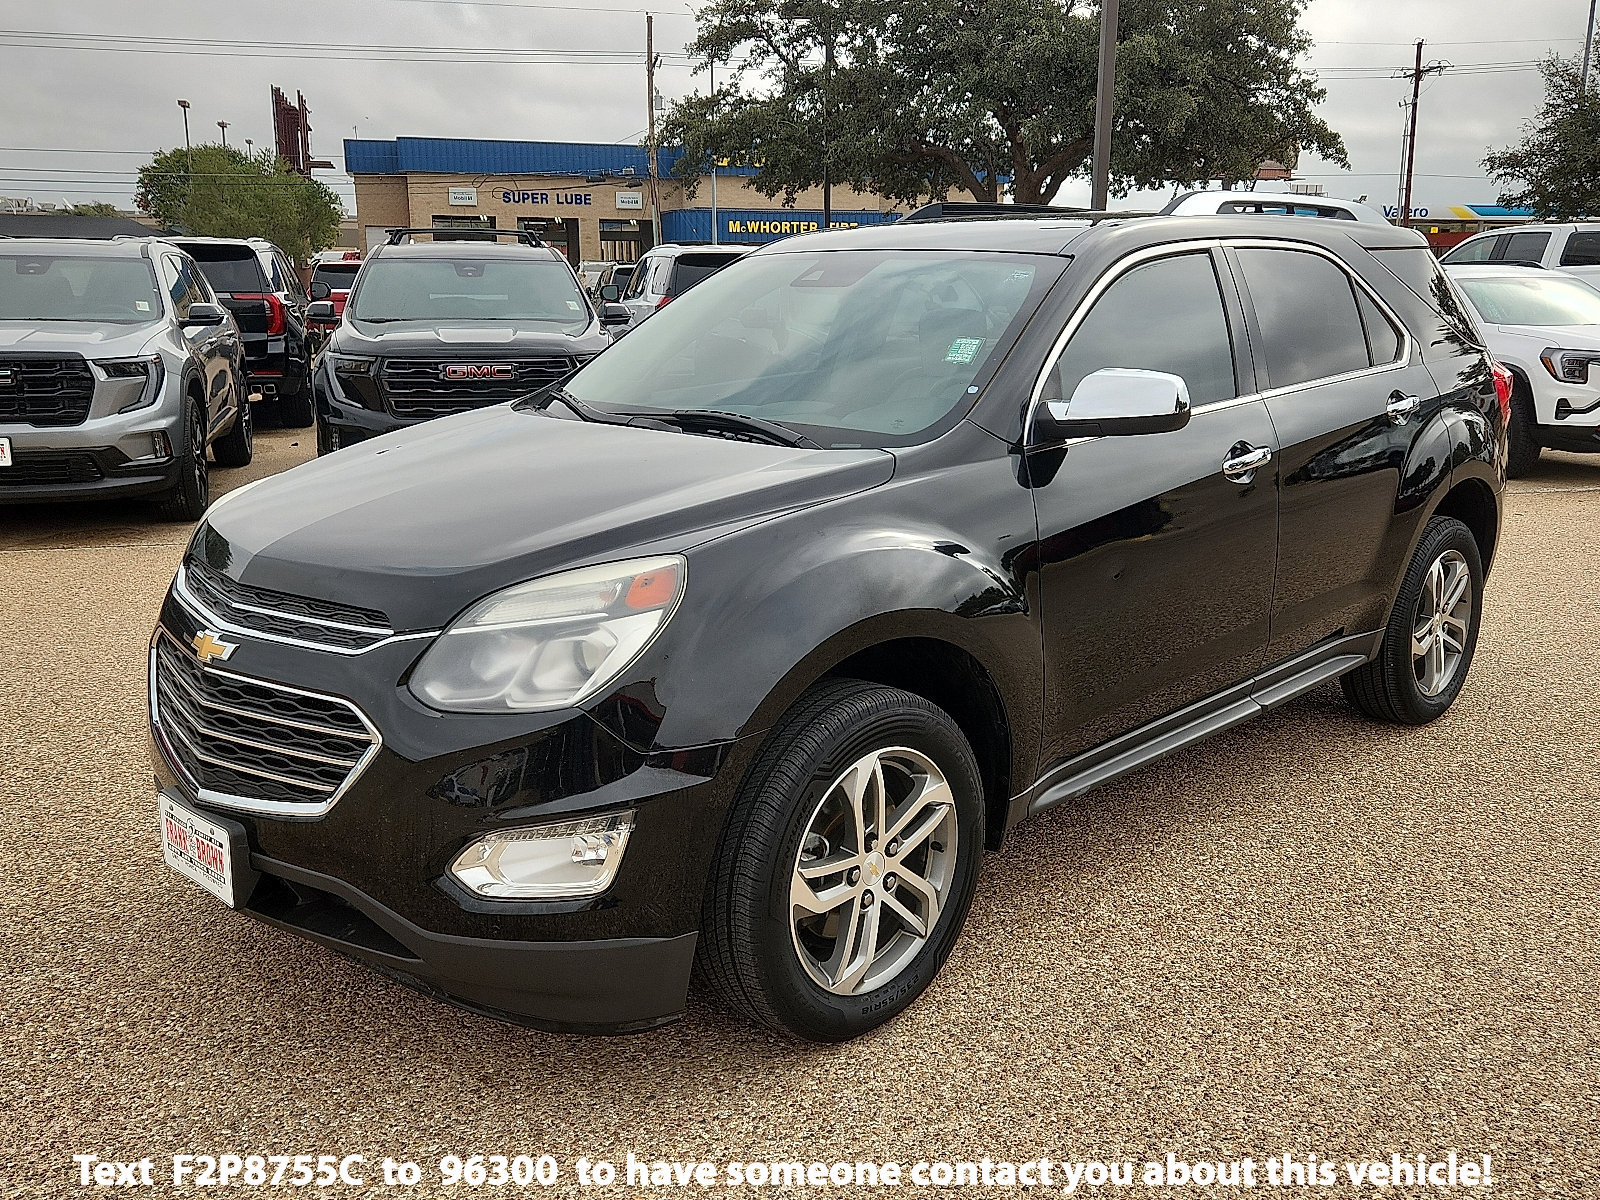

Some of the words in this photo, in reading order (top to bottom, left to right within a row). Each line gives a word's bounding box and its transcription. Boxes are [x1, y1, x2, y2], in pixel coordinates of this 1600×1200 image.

[502, 191, 549, 204] SUPER
[556, 193, 592, 205] LUBE
[728, 220, 819, 234] McWHORTER
[446, 365, 512, 379] GMC
[165, 817, 189, 854] FRANK
[195, 837, 225, 875] BROWN
[861, 973, 920, 1015] 235/55R18
